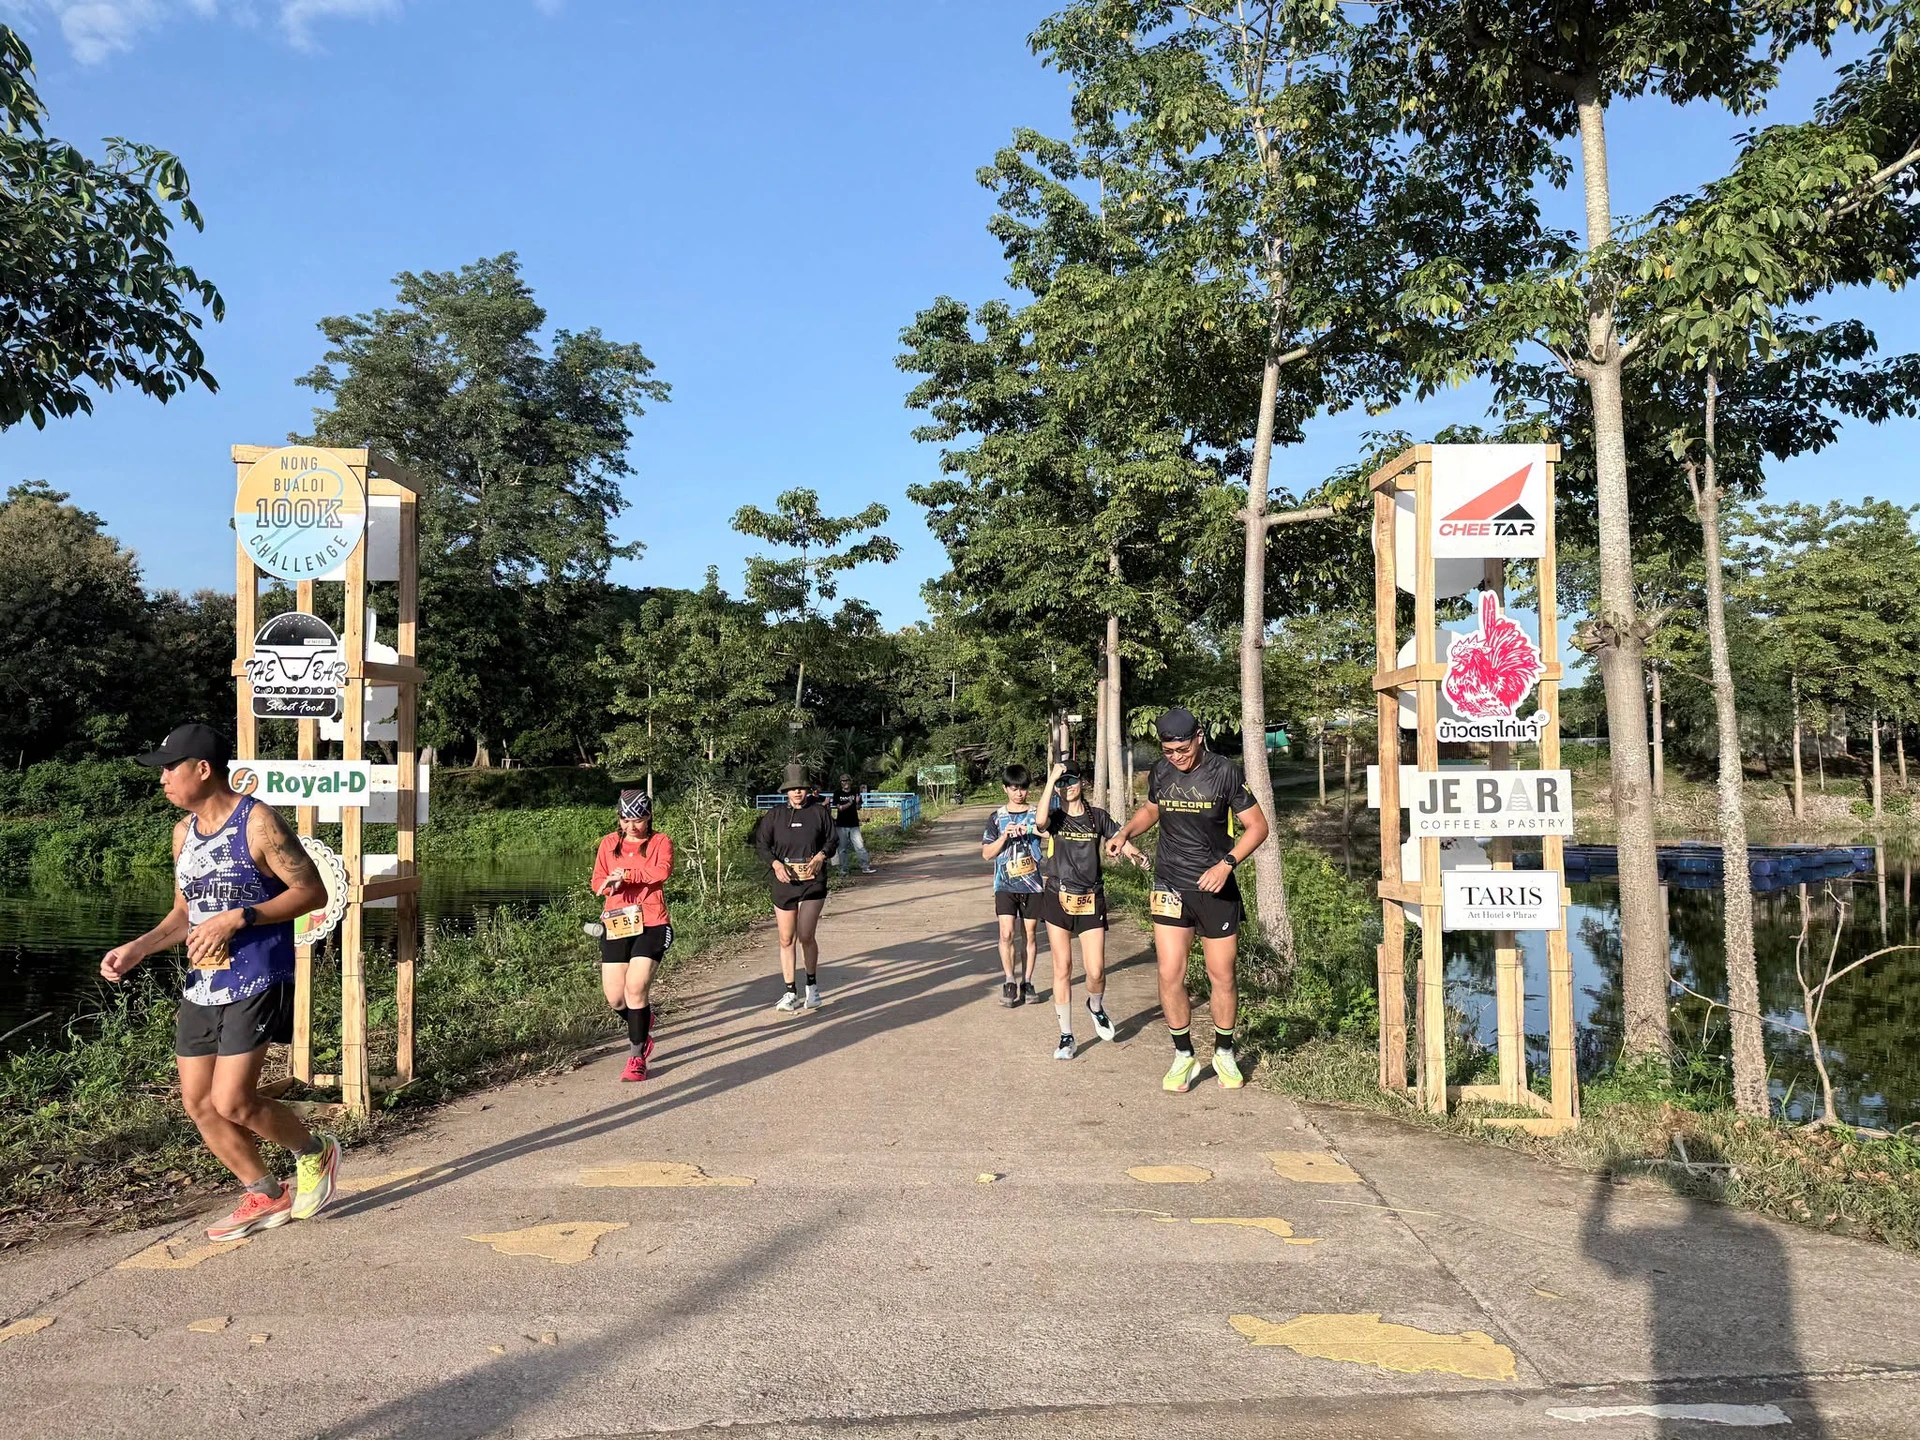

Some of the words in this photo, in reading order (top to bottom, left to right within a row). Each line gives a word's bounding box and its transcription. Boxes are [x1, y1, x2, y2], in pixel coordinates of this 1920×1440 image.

[280, 456, 318, 470] NONG
[274, 478, 324, 492] BUALOI
[256, 498, 343, 528] 100K
[1439, 523, 1536, 536] CHEETAR
[250, 534, 348, 573] CHALLENGE
[245, 660, 276, 682] THE
[312, 660, 347, 682] BAR
[266, 700, 298, 712] Street
[299, 701, 325, 713] Food
[1440, 719, 1538, 738] ข้าวตราไก่แจ้
[267, 771, 366, 798] Royal-D
[1419, 779, 1462, 814] JE
[1476, 778, 1560, 814] BAR
[1420, 820, 1481, 830] COFFEE
[1490, 820, 1499, 829] &
[1507, 819, 1565, 829] PASTRY
[1066, 896, 1073, 904] F
[1077, 896, 1092, 905] 554
[1460, 886, 1543, 906] TARIS
[1468, 911, 1480, 919] Art
[1483, 911, 1504, 919] Hotel
[1513, 911, 1537, 919] Phrae
[612, 919, 618, 928] F
